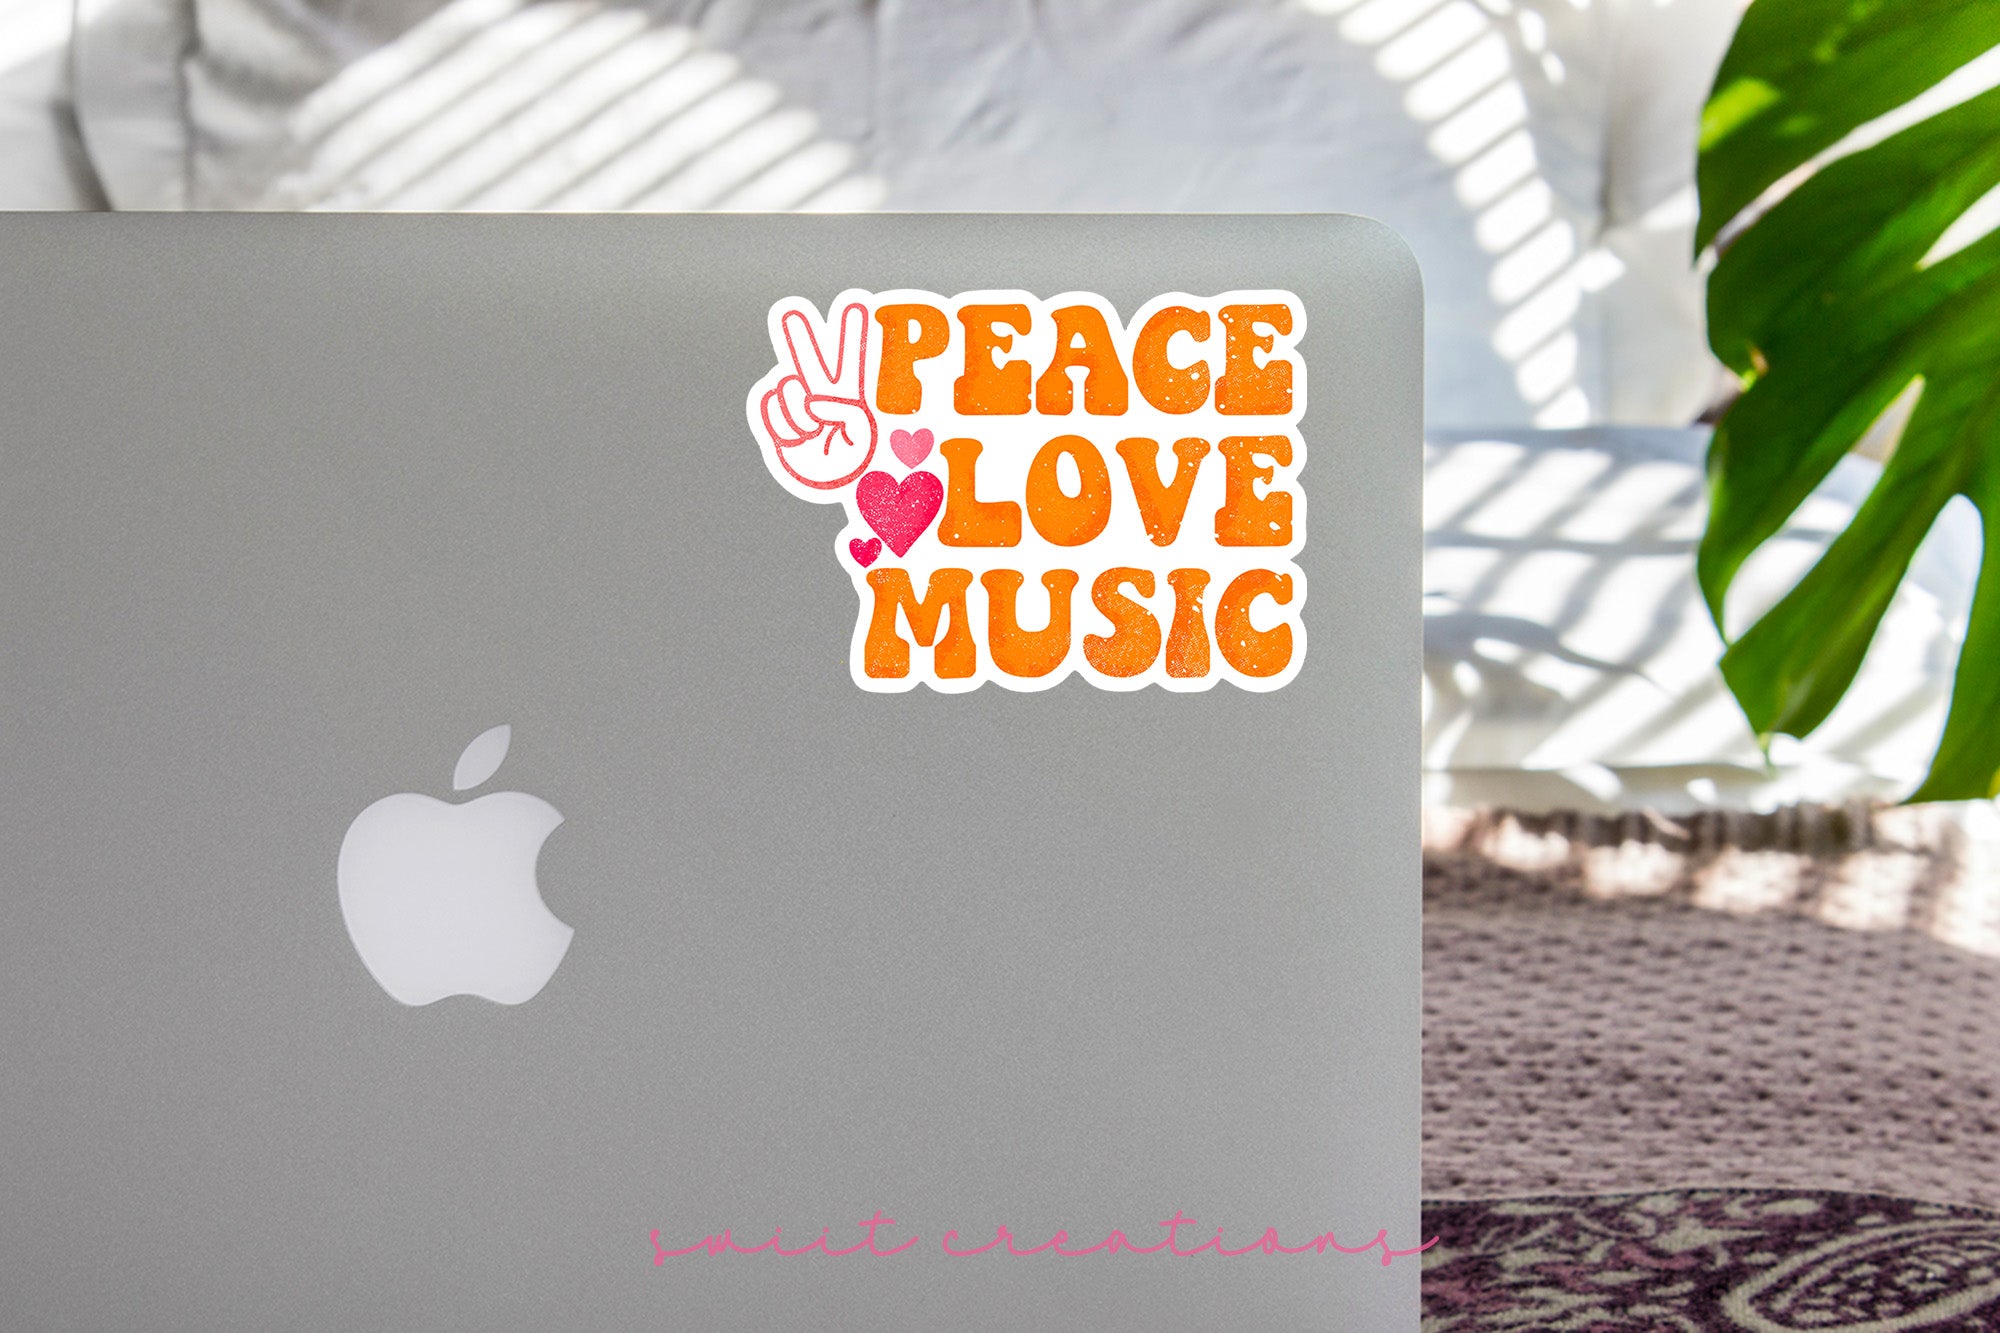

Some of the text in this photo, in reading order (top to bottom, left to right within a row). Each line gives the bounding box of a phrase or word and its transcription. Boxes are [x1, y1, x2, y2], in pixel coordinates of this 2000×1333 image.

[874, 303, 1293, 416] PEACE
[937, 434, 1293, 548] LOVE
[864, 566, 1293, 679] MUSIC
